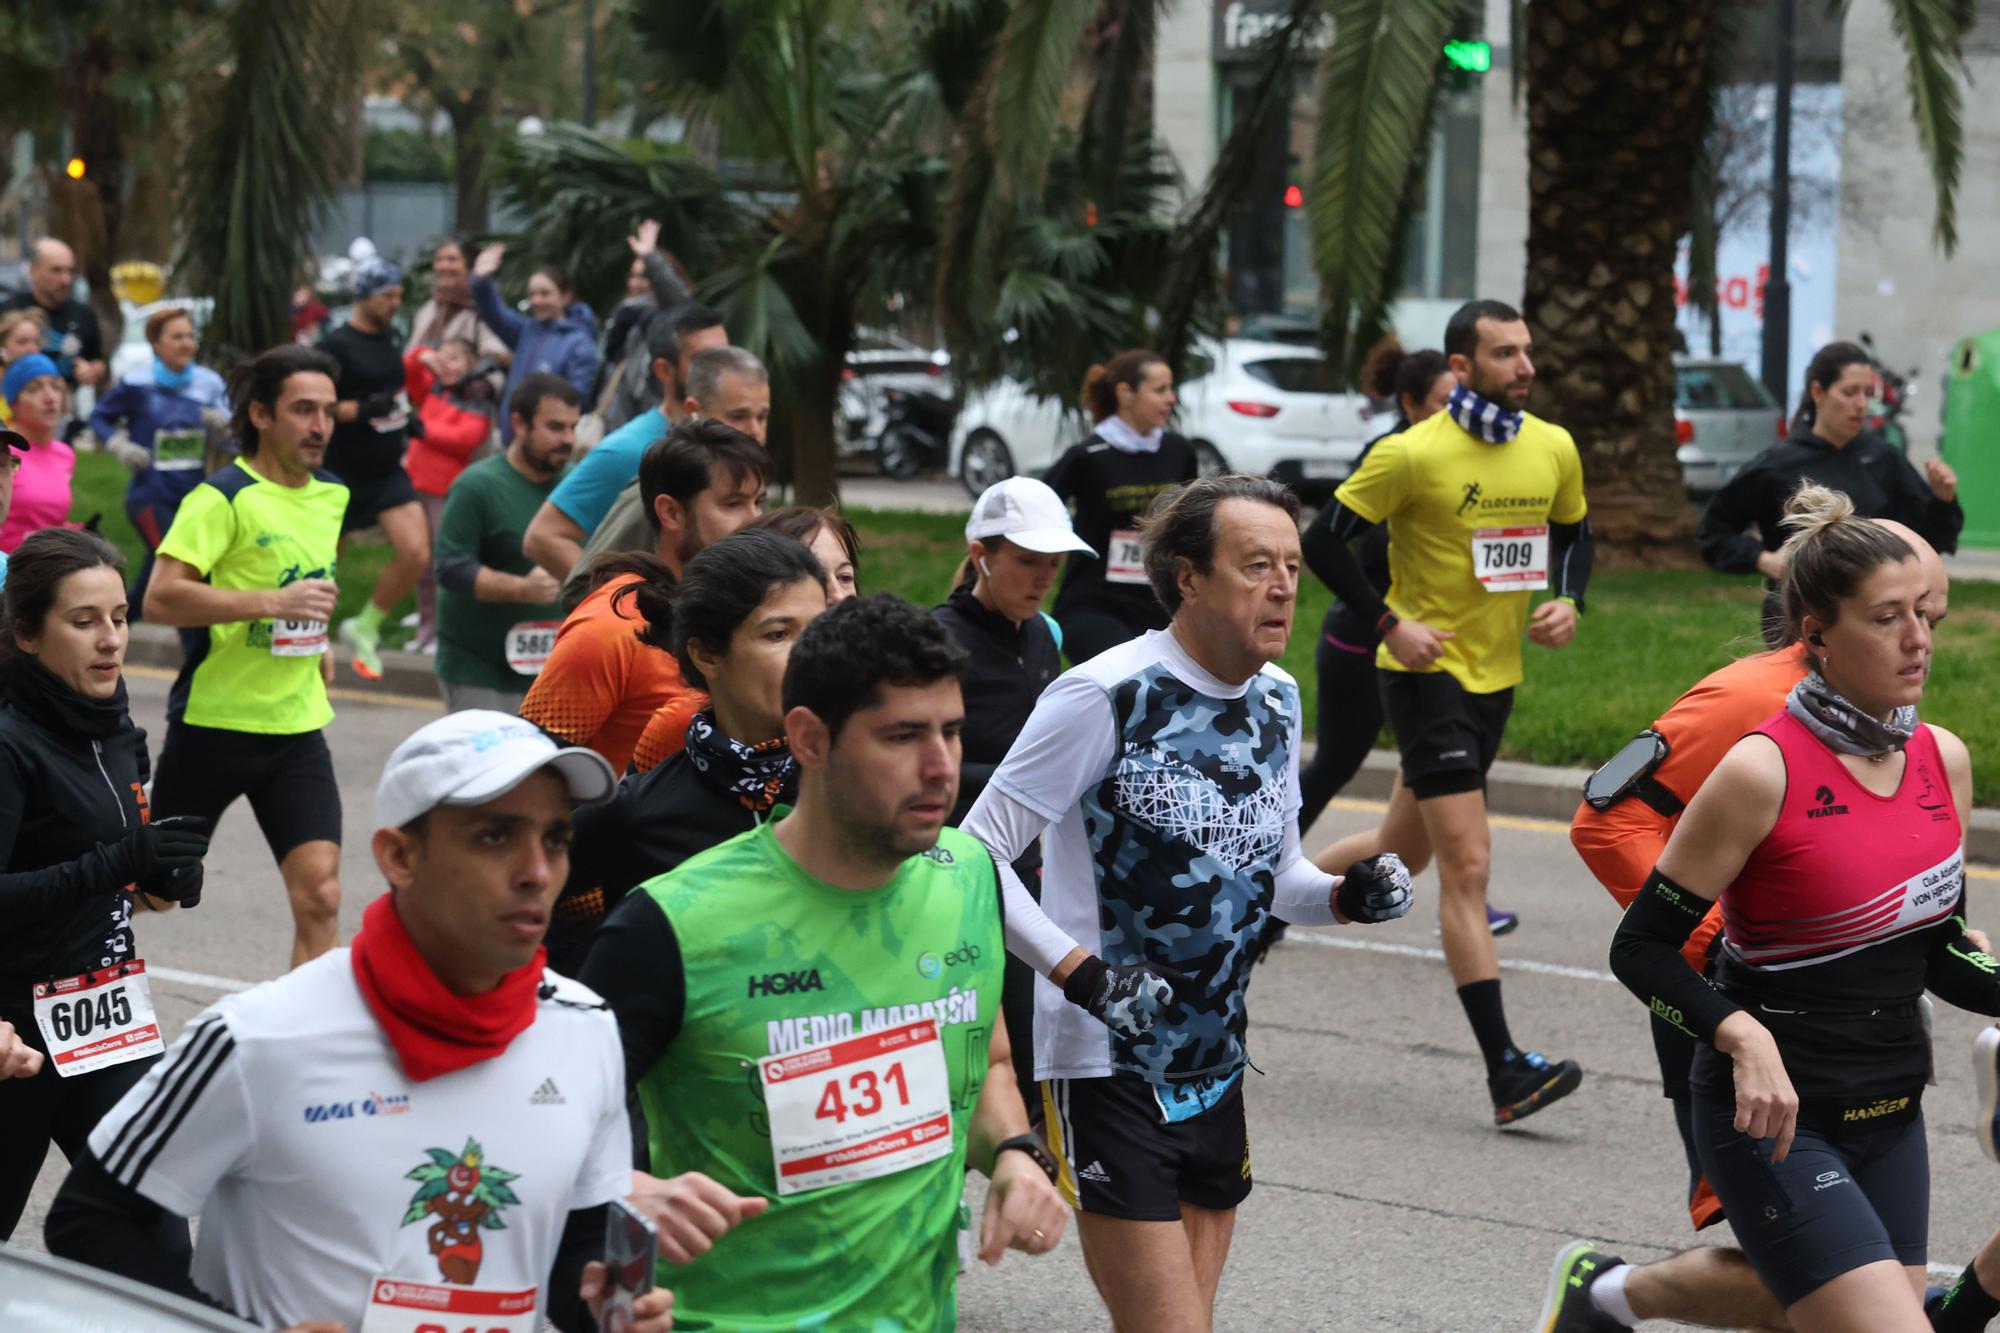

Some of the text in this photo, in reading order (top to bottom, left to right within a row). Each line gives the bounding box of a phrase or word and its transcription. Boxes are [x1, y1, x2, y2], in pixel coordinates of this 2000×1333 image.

[1481, 497, 1550, 509] CLOCKWORK
[1483, 542, 1532, 568] 7309
[1807, 804, 1849, 819] VIATOR
[1658, 883, 1681, 900] PRO
[1922, 874, 1940, 888] Club
[1912, 892, 1931, 907] VON
[944, 941, 981, 967] edp
[748, 968, 824, 998] HOKA
[51, 986, 132, 1042] 6045
[768, 1013, 853, 1054] MEDIO
[815, 1062, 910, 1124] 431
[1079, 1171, 1112, 1183] adidas
